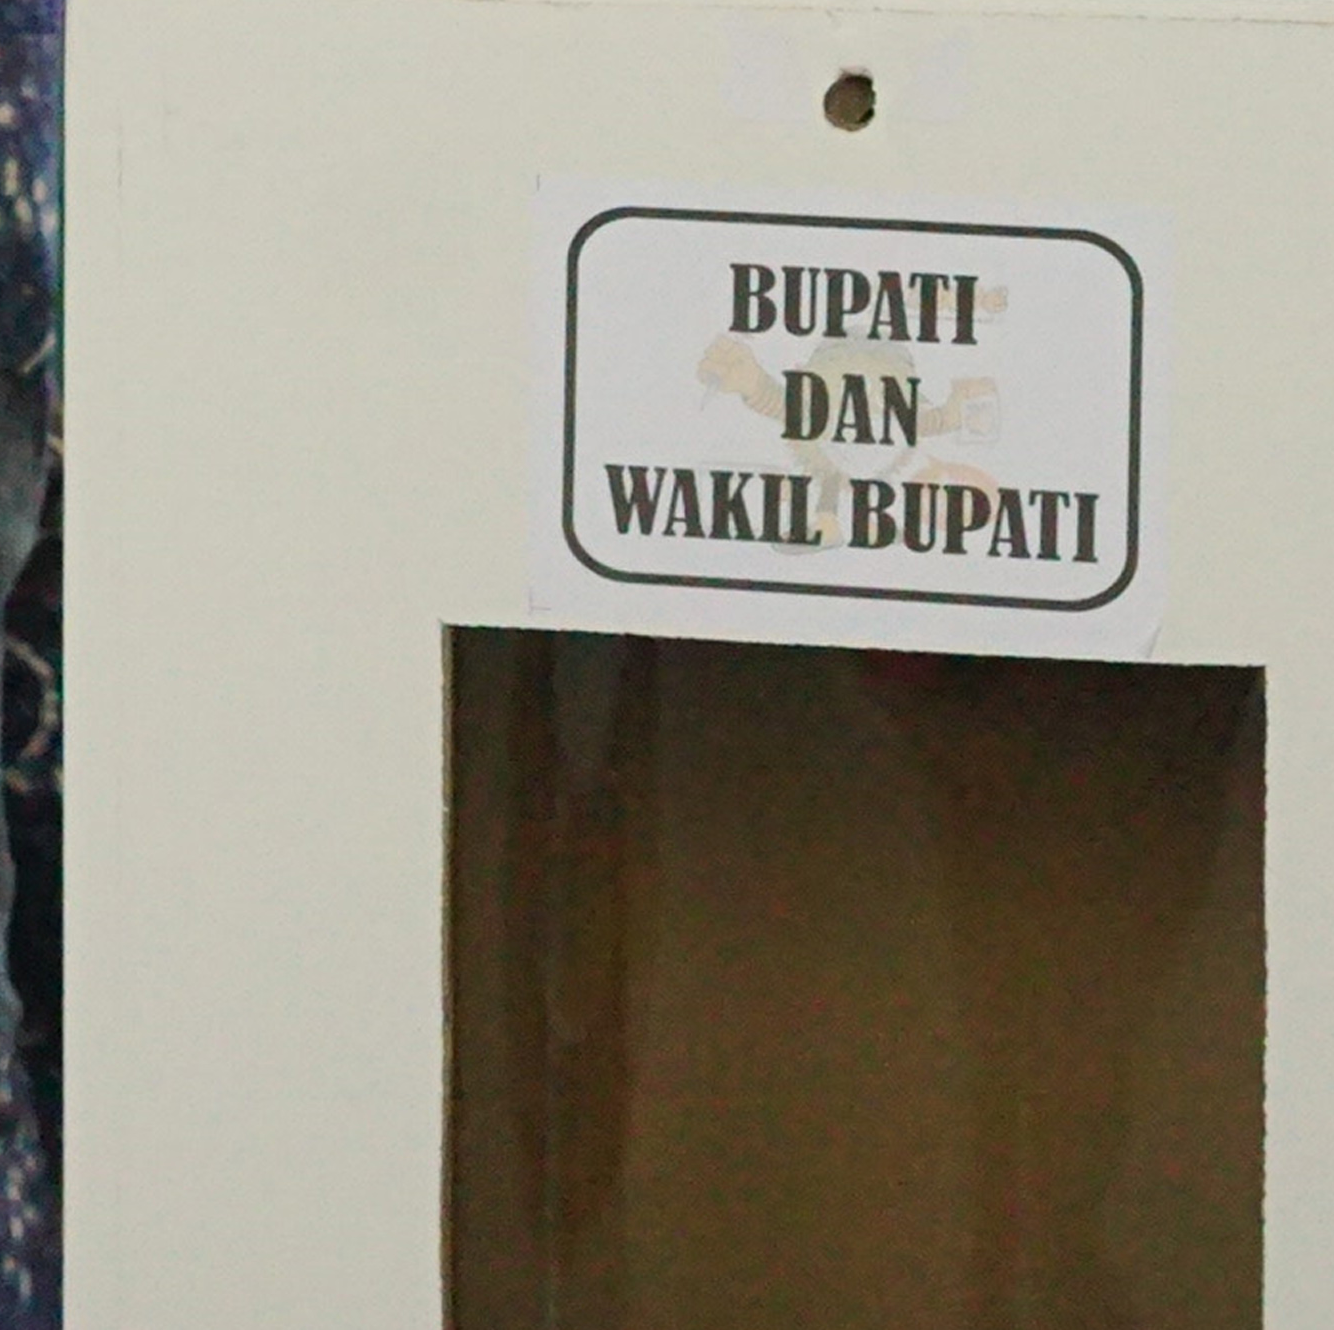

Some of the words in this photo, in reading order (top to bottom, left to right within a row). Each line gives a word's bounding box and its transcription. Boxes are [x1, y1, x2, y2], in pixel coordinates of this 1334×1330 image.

[729, 262, 979, 345] BUPATI
[781, 370, 921, 447] DAN
[604, 464, 822, 546] WAKIL
[849, 478, 1100, 563] BUPATI
